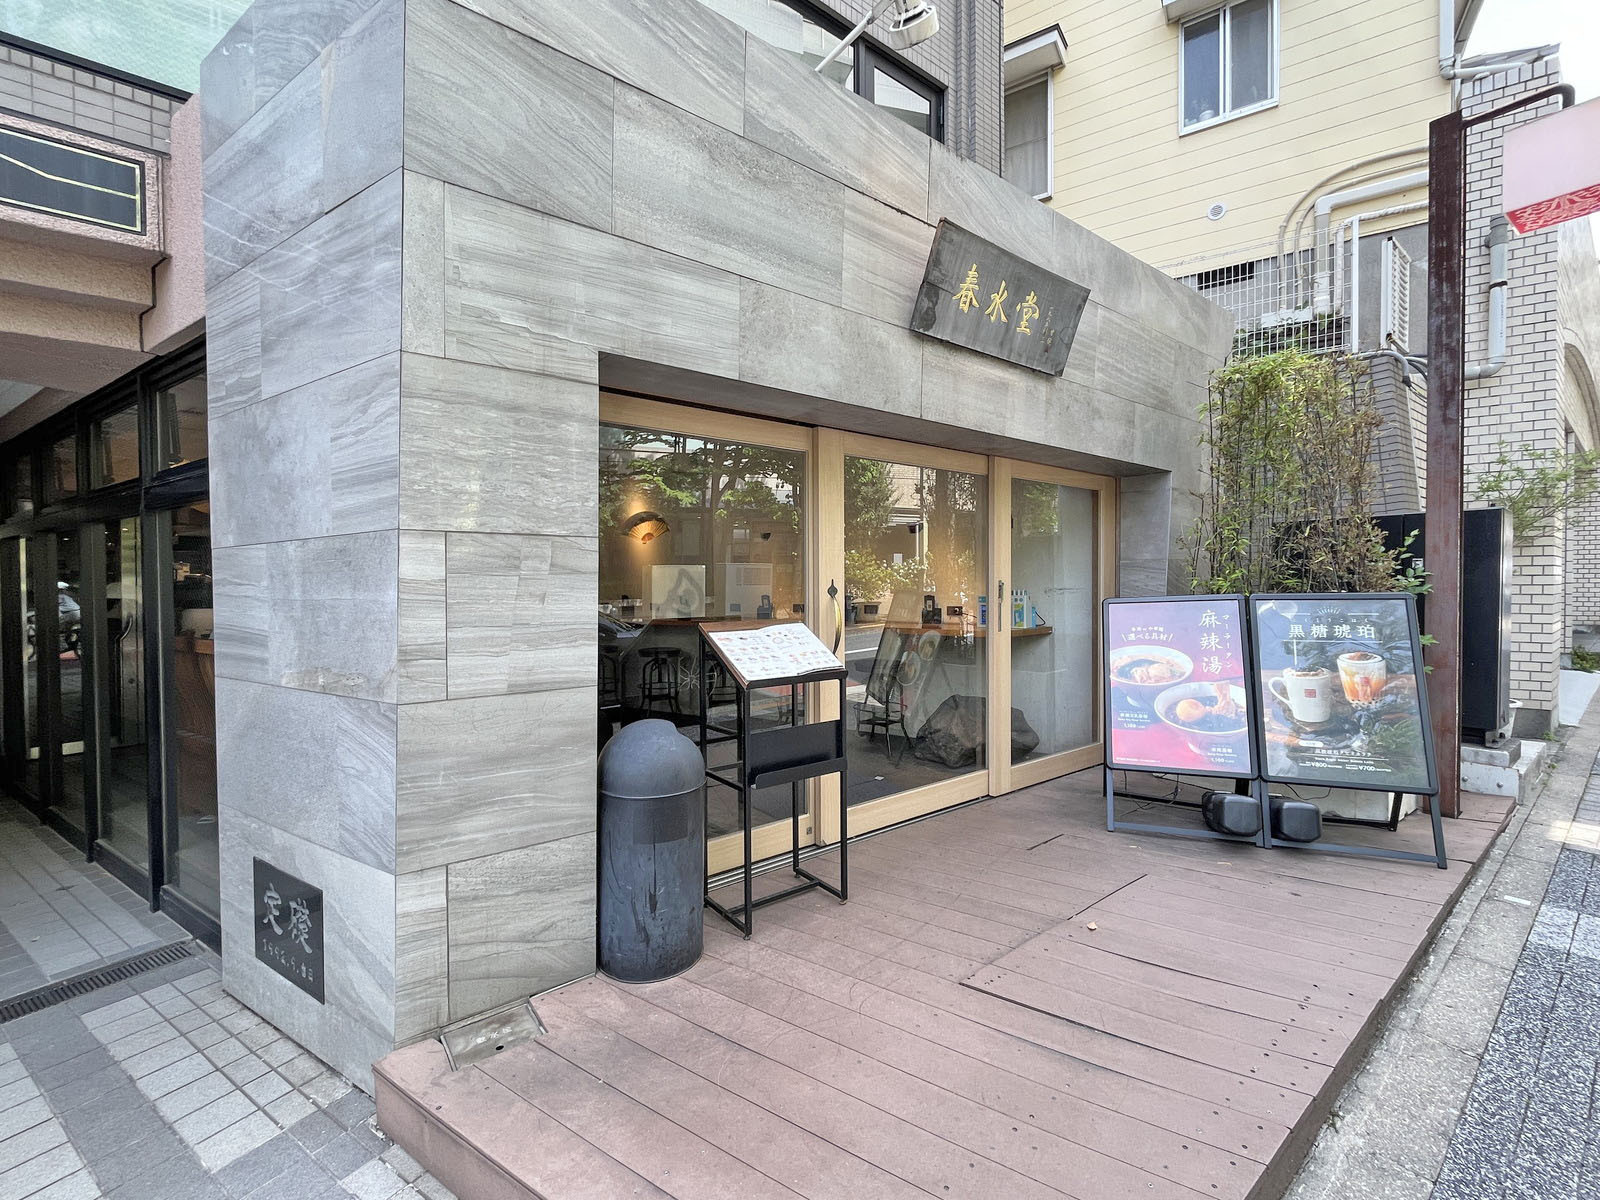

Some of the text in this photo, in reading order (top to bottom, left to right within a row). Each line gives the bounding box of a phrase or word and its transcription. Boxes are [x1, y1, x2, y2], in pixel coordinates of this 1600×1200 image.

[952, 263, 1040, 336] 春水堂
[1198, 609, 1223, 675] 麻辣湯
[1288, 623, 1376, 639] 黒糖琥珀
[262, 882, 313, 954] 定礎
